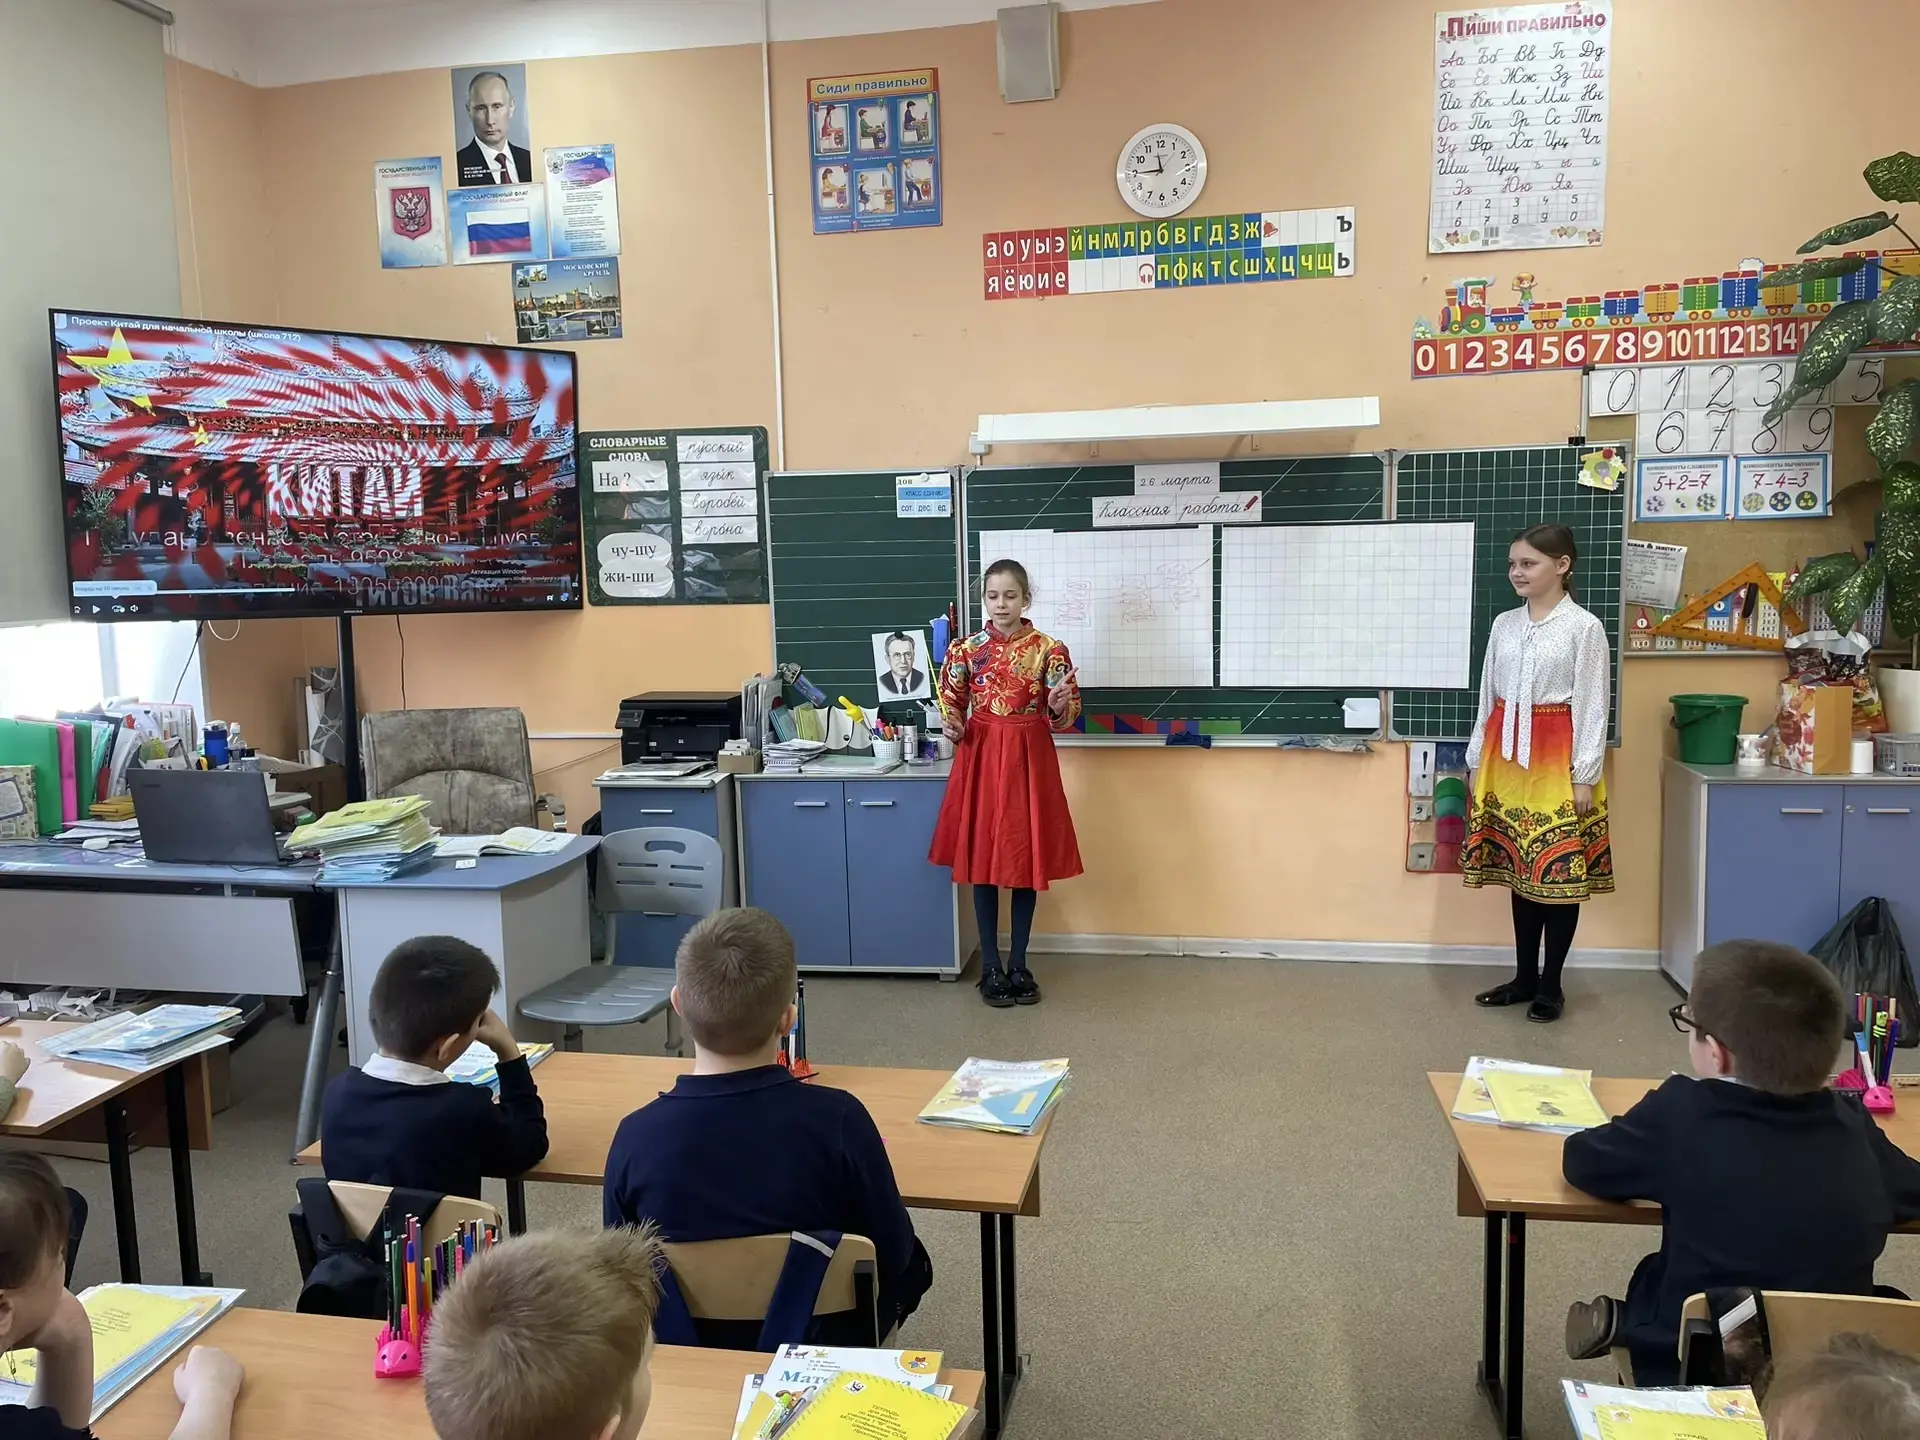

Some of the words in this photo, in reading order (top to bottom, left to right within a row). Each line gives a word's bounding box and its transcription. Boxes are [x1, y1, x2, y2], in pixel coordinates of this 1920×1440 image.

[817, 83, 850, 94] Сиди
[855, 77, 927, 93] правильно
[1145, 145, 1151, 153] 11
[1157, 140, 1165, 148] 12
[1181, 151, 1186, 159] 2
[1147, 191, 1153, 199] 7
[1159, 193, 1165, 201] 6
[1173, 188, 1178, 196] 5
[1456, 200, 1462, 210] 1
[1485, 199, 1491, 209] 2
[1513, 198, 1520, 207] 3
[1542, 196, 1548, 206] 4
[1571, 194, 1578, 204] 5
[1455, 217, 1462, 227] 6
[1484, 216, 1490, 226] 7
[1512, 215, 1519, 224] 8
[1541, 213, 1548, 222] 9
[1570, 212, 1577, 221] 0
[72, 317, 109, 327] Проект
[111, 319, 140, 330] Китай
[142, 322, 159, 332] для
[162, 323, 212, 335] начальной
[214, 328, 246, 337] школы
[247, 330, 280, 341] (школа
[282, 333, 301, 342] 712)
[1416, 344, 1436, 372] 0
[1444, 343, 1456, 369] 1
[1465, 342, 1484, 368] 2
[1491, 340, 1508, 367] 3
[1514, 338, 1535, 365] 4
[1541, 337, 1559, 364] 5
[1565, 335, 1585, 363] 6
[1592, 334, 1611, 361] 7
[1616, 332, 1636, 359] 8
[1643, 330, 1663, 358] 9
[1667, 329, 1691, 356] 10
[1695, 327, 1716, 355] 11
[1720, 325, 1743, 353] 12
[1746, 324, 1770, 352] 13
[1773, 323, 1797, 350] 14
[1607, 370, 1635, 412] 0
[1664, 366, 1686, 410] 1
[1706, 364, 1734, 408] 2
[1753, 363, 1782, 406] 3
[1852, 360, 1882, 402] 5
[1656, 411, 1684, 453] 6
[1707, 410, 1733, 452] 7
[1802, 408, 1832, 451] 9
[590, 436, 666, 448] СЛОВАРНЫЕ
[609, 452, 650, 461] СЛОВА
[599, 473, 618, 486] На
[1161, 475, 1212, 490] марта
[267, 458, 424, 518] КИТАЙ
[1099, 501, 1171, 518] Классная
[1178, 496, 1241, 521] работа
[604, 573, 654, 582] жи-ши
